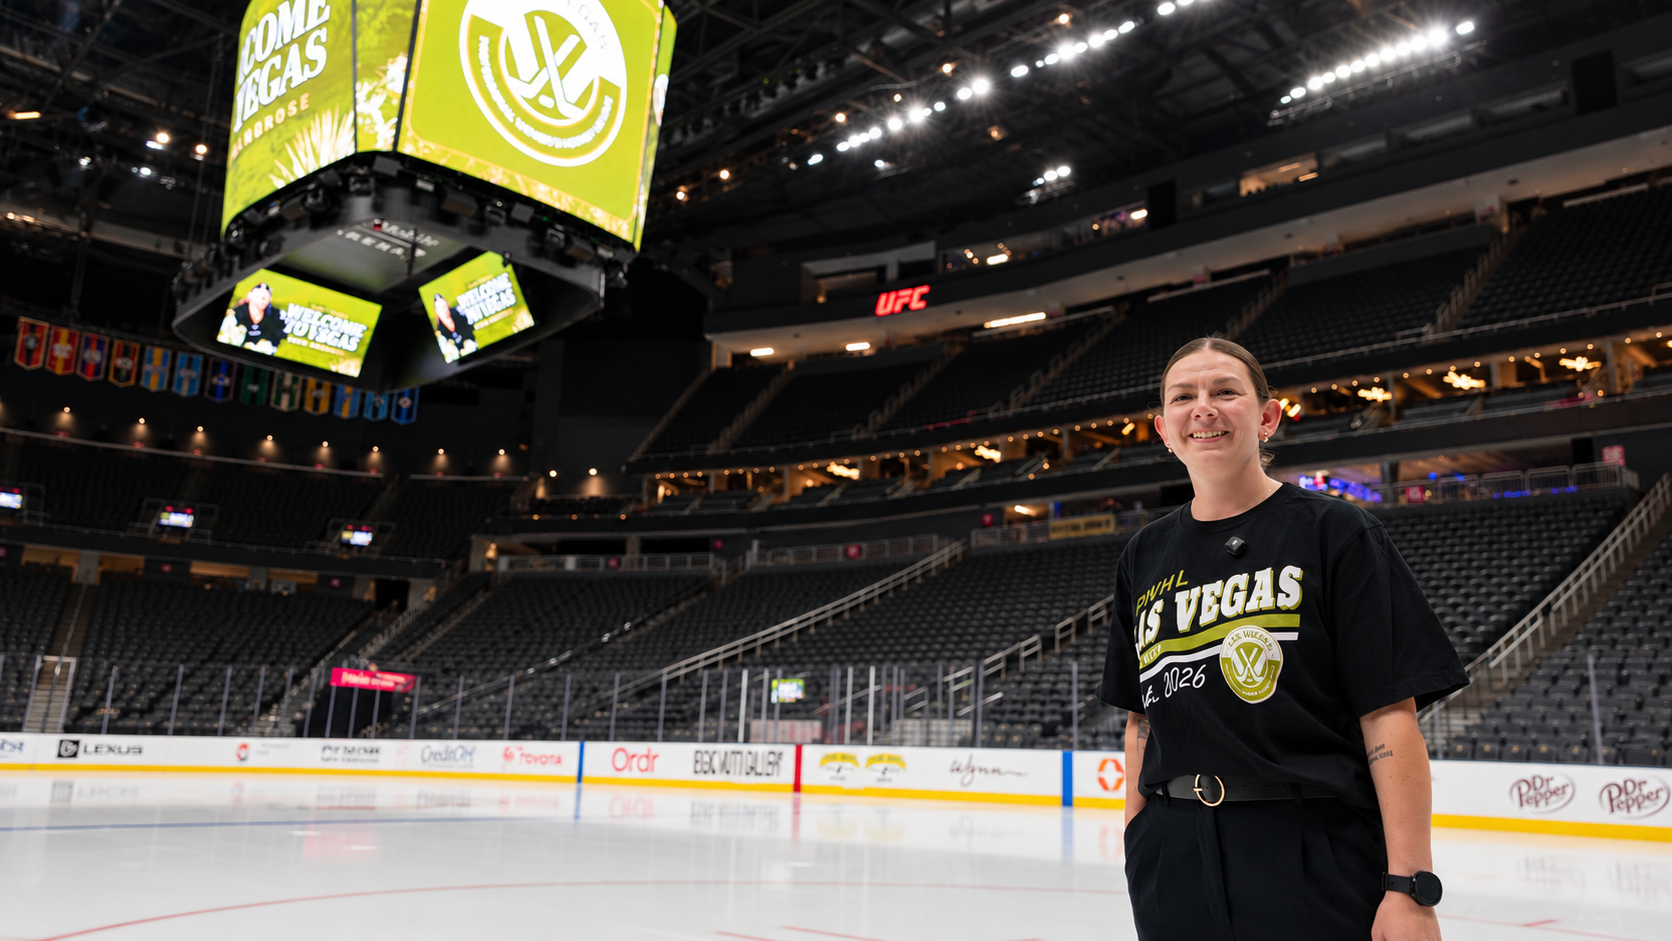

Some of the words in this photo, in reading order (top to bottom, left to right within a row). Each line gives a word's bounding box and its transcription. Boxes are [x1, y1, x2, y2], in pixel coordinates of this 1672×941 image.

[875, 285, 930, 317] UFC
[1175, 565, 1303, 633] VEGAS
[83, 743, 143, 755] LEXUS
[519, 751, 563, 765] TOYOTA
[612, 747, 659, 773] Ordr
[1516, 778, 1569, 808] Pepper
[1532, 775, 1553, 791] Dr
[1624, 778, 1647, 796] Dr
[1607, 782, 1664, 814] Pepper
